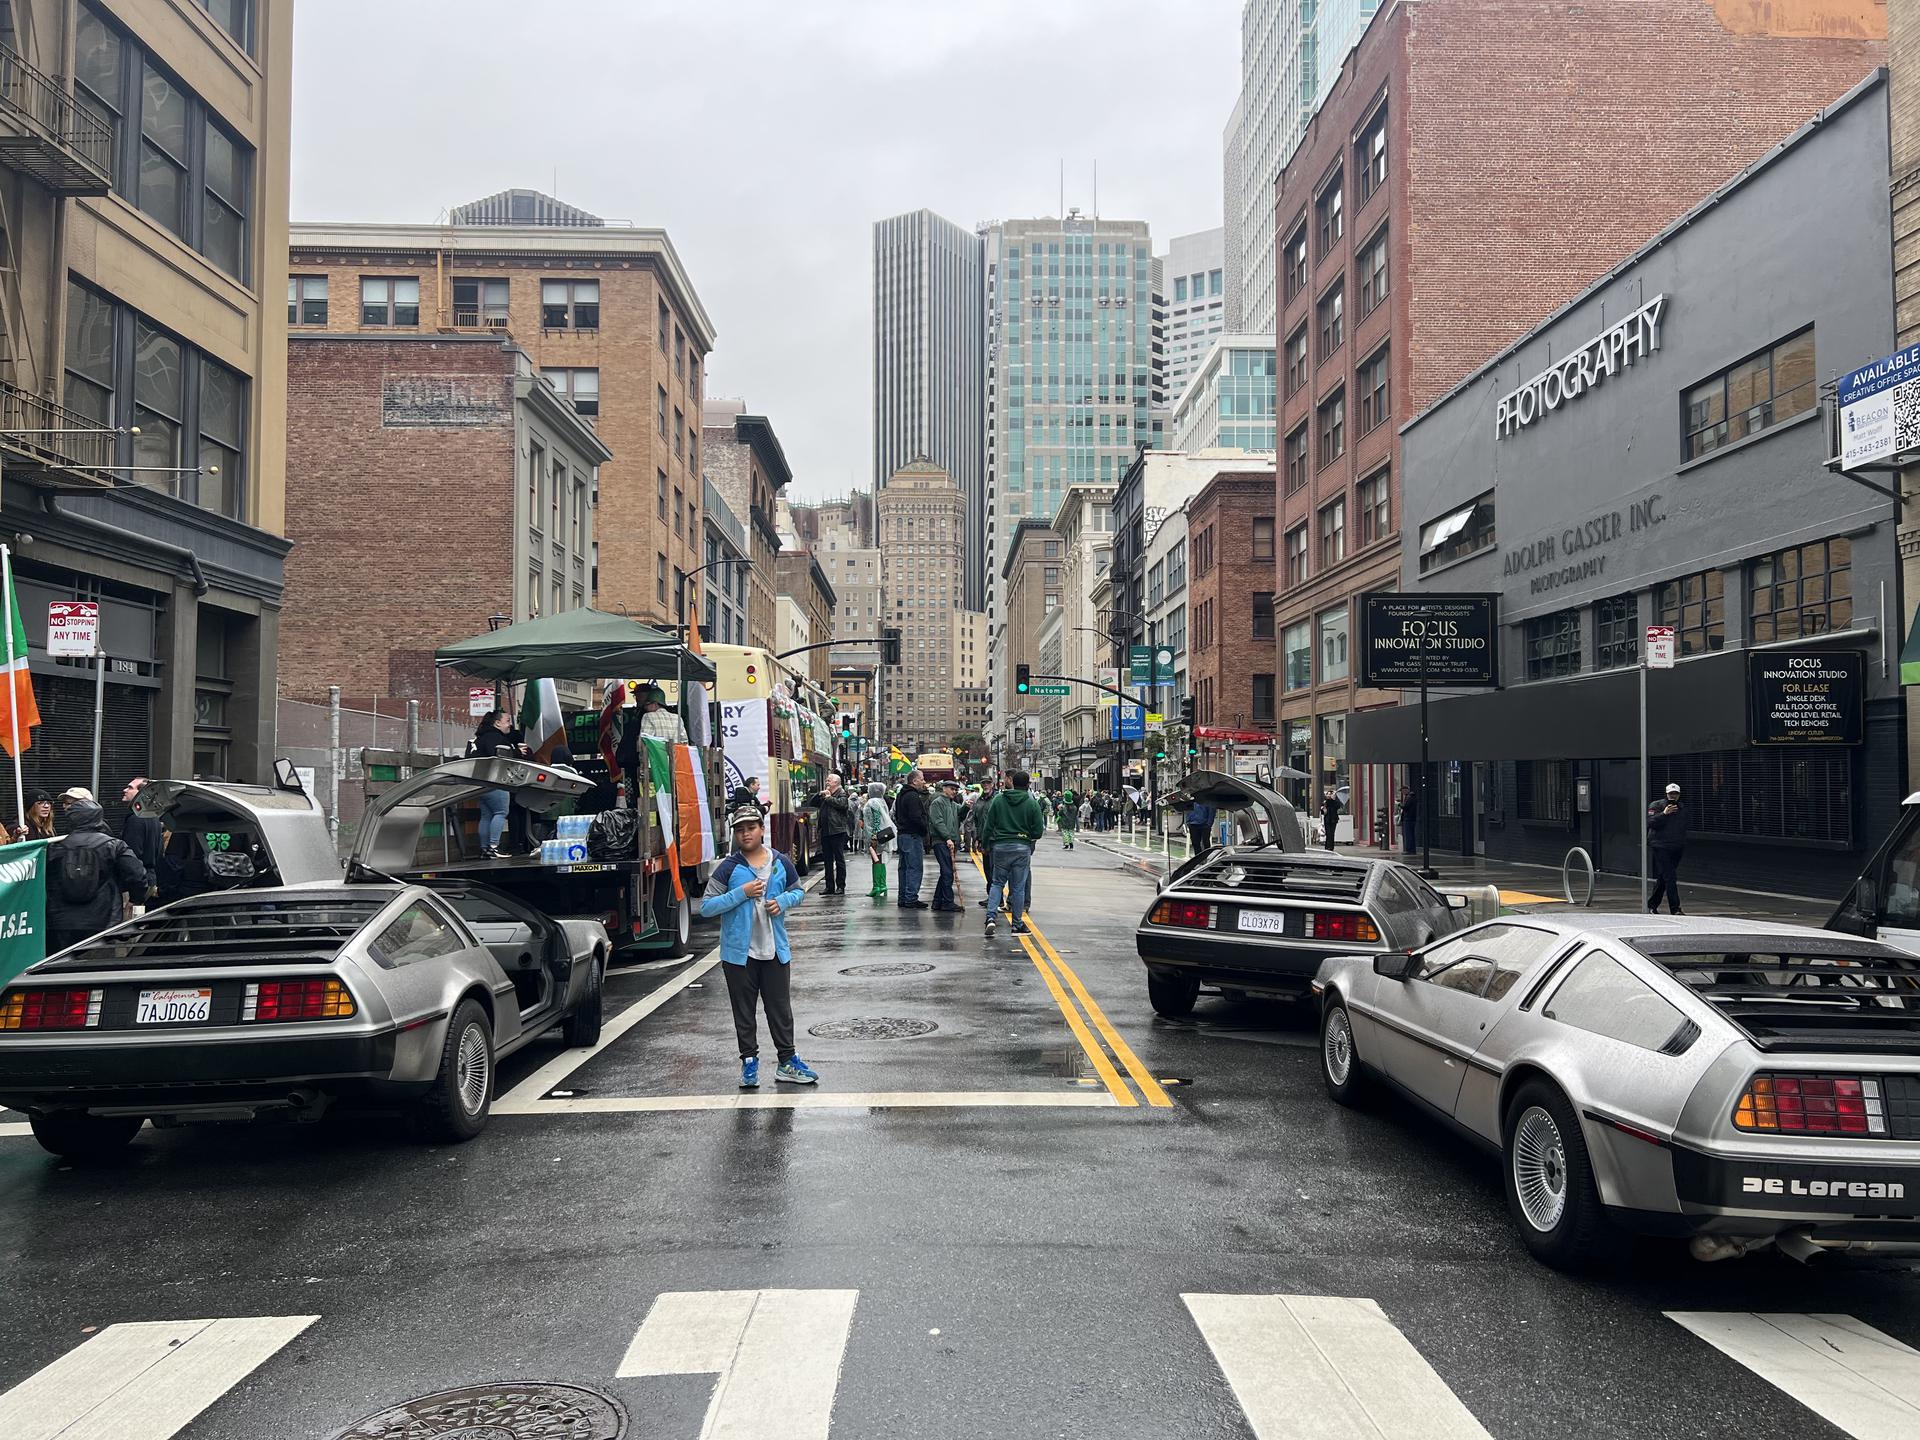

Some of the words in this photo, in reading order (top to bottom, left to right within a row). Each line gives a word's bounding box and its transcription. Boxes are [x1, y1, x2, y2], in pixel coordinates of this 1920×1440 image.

[1496, 296, 1666, 440] PHOTOGRAPHY
[1853, 347, 1919, 388] AVAILABLE
[1844, 384, 1875, 403] CREATIVE
[1877, 371, 1902, 389] OFFICE
[1856, 406, 1889, 426] BEACON
[1503, 535, 1555, 577] ADOLPH
[1562, 511, 1622, 556] GASSER
[1630, 494, 1667, 532] INC.
[1530, 556, 1606, 595] PHOTOGRAPHY
[51, 617, 65, 626] NO
[67, 618, 95, 626] STOPPING
[1402, 620, 1458, 636] FOCUS
[54, 631, 70, 640] ANY
[73, 631, 91, 640] TIME
[1375, 637, 1442, 650] INNOVATON
[1445, 637, 1485, 650] STUDIO
[117, 660, 134, 673] 184
[1788, 658, 1822, 668] FOCUS
[1763, 671, 1817, 679] INNOVATION
[1818, 671, 1848, 679] STUDIO
[1782, 684, 1801, 693] FOR
[1803, 684, 1830, 693] LEASE
[721, 705, 745, 718] RY
[1770, 711, 1800, 719] GROUND
[1800, 711, 1820, 719] LEVEL
[1821, 711, 1842, 719] RETAIL
[153, 991, 197, 1002] California
[140, 1002, 207, 1022] 7AJD066
